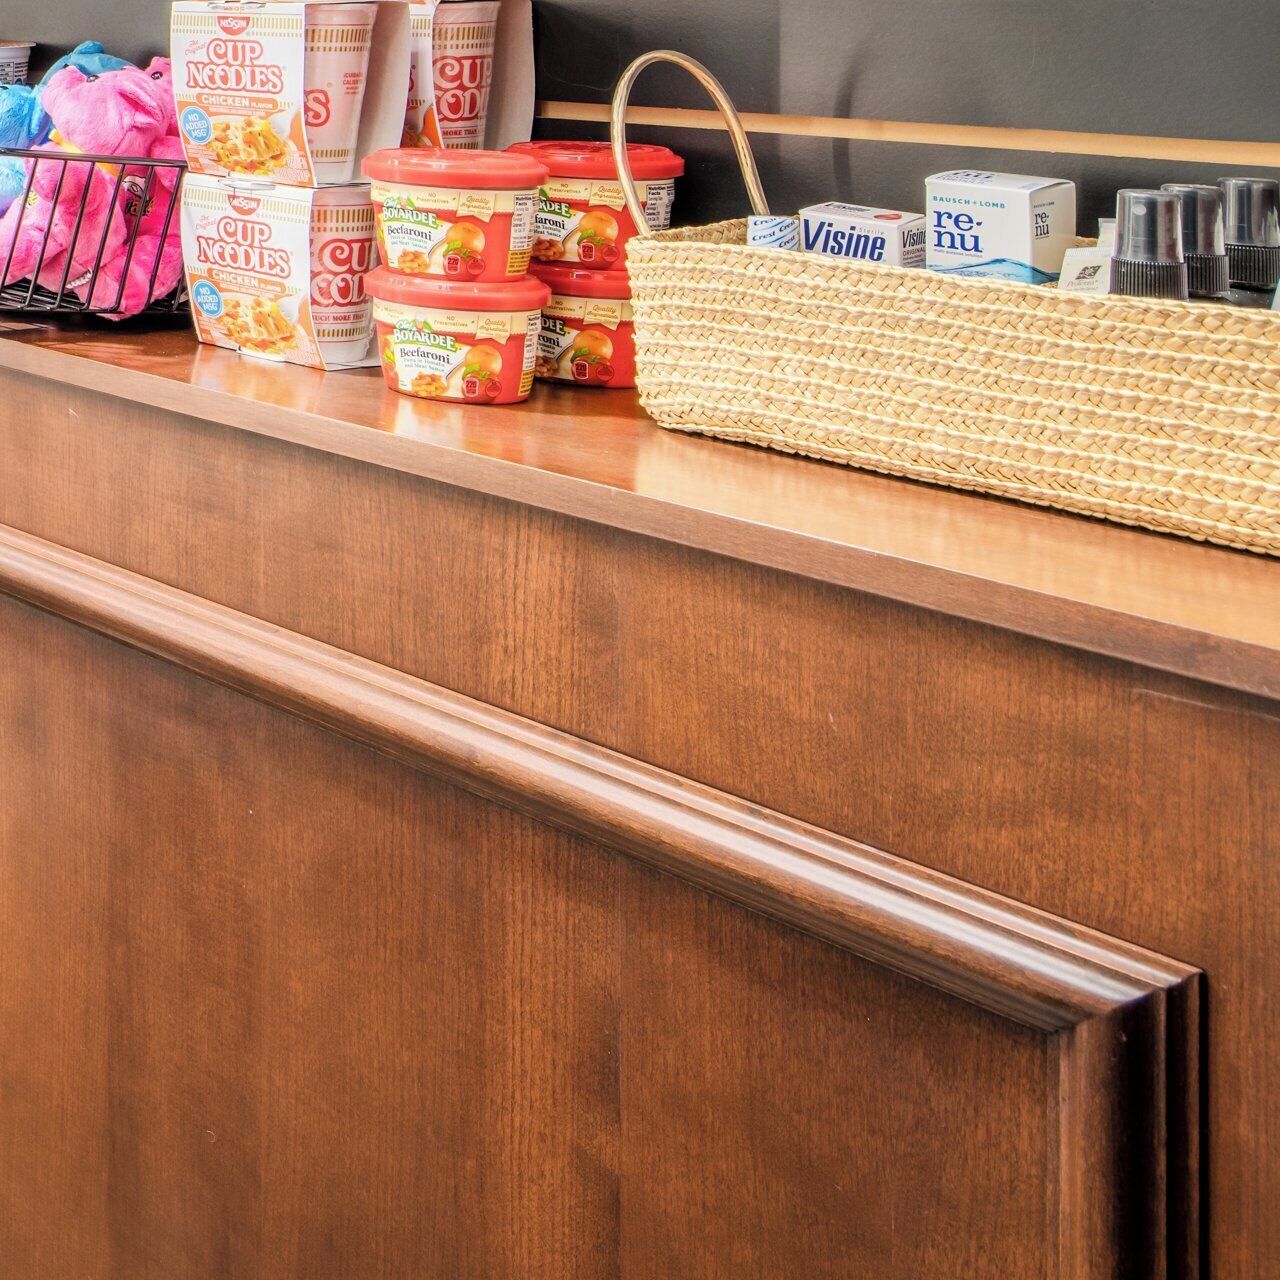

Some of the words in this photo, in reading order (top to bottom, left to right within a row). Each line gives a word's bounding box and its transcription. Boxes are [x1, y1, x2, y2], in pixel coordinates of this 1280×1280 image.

[218, 16, 248, 29] NISSIN
[207, 38, 263, 70] CUP
[186, 64, 283, 93] NOODLES
[201, 95, 250, 107] CHICKEN
[184, 121, 208, 131] ADDED
[465, 195, 490, 204] Quality
[932, 195, 970, 205] BAUSCH
[980, 201, 1006, 209] LOMB
[382, 207, 438, 229] BOYARDEE
[217, 217, 272, 249] CUP
[387, 225, 433, 242] Beefaroni
[752, 231, 776, 241] Crest
[779, 235, 795, 248] Crest
[803, 218, 886, 262] Visine
[902, 228, 926, 248] Visine
[933, 230, 983, 253] nu
[198, 240, 290, 279] NOODLES
[484, 318, 507, 327] Quality
[392, 328, 456, 350] BOYARDEE
[399, 347, 450, 364] Beefaroni
[465, 380, 478, 389] 220
